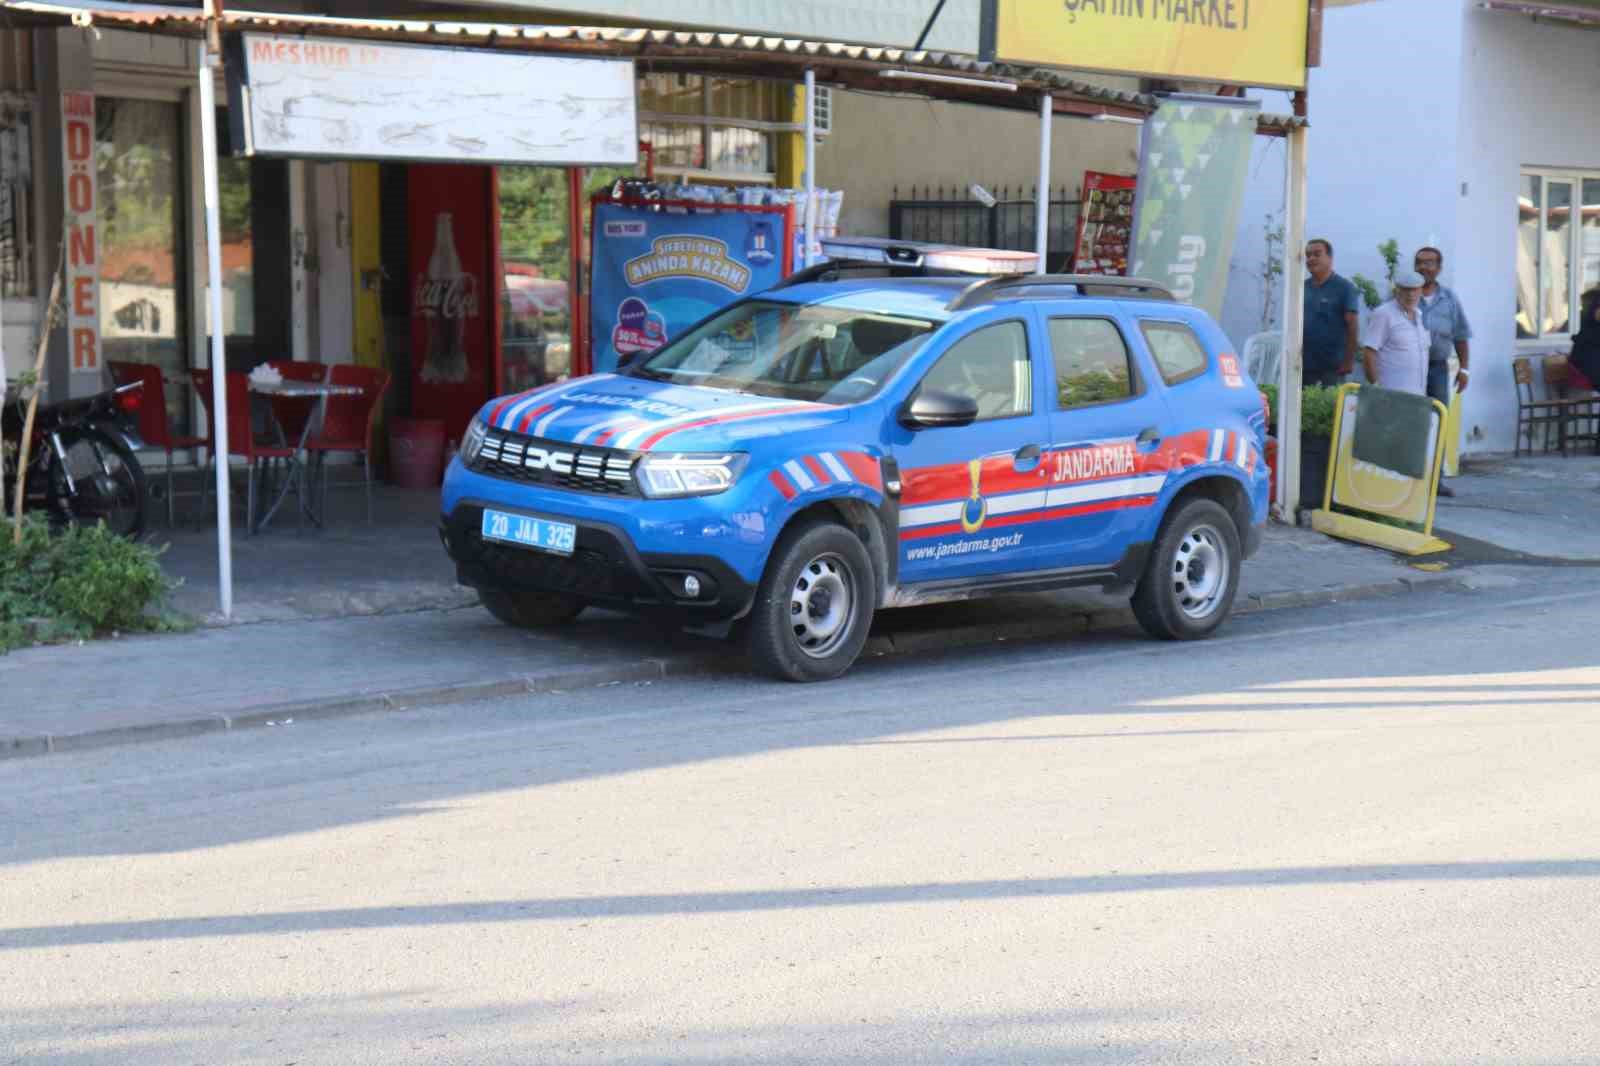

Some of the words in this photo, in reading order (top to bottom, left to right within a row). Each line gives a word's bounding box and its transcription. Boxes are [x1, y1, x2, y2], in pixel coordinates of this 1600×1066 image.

[66, 121, 97, 369] DÖNER
[1053, 445, 1135, 481] JANDARMA
[491, 514, 509, 536] 20
[514, 519, 539, 544] JAA
[546, 523, 572, 549] 325
[906, 532, 1024, 561] www.jandarma.gov.tr
